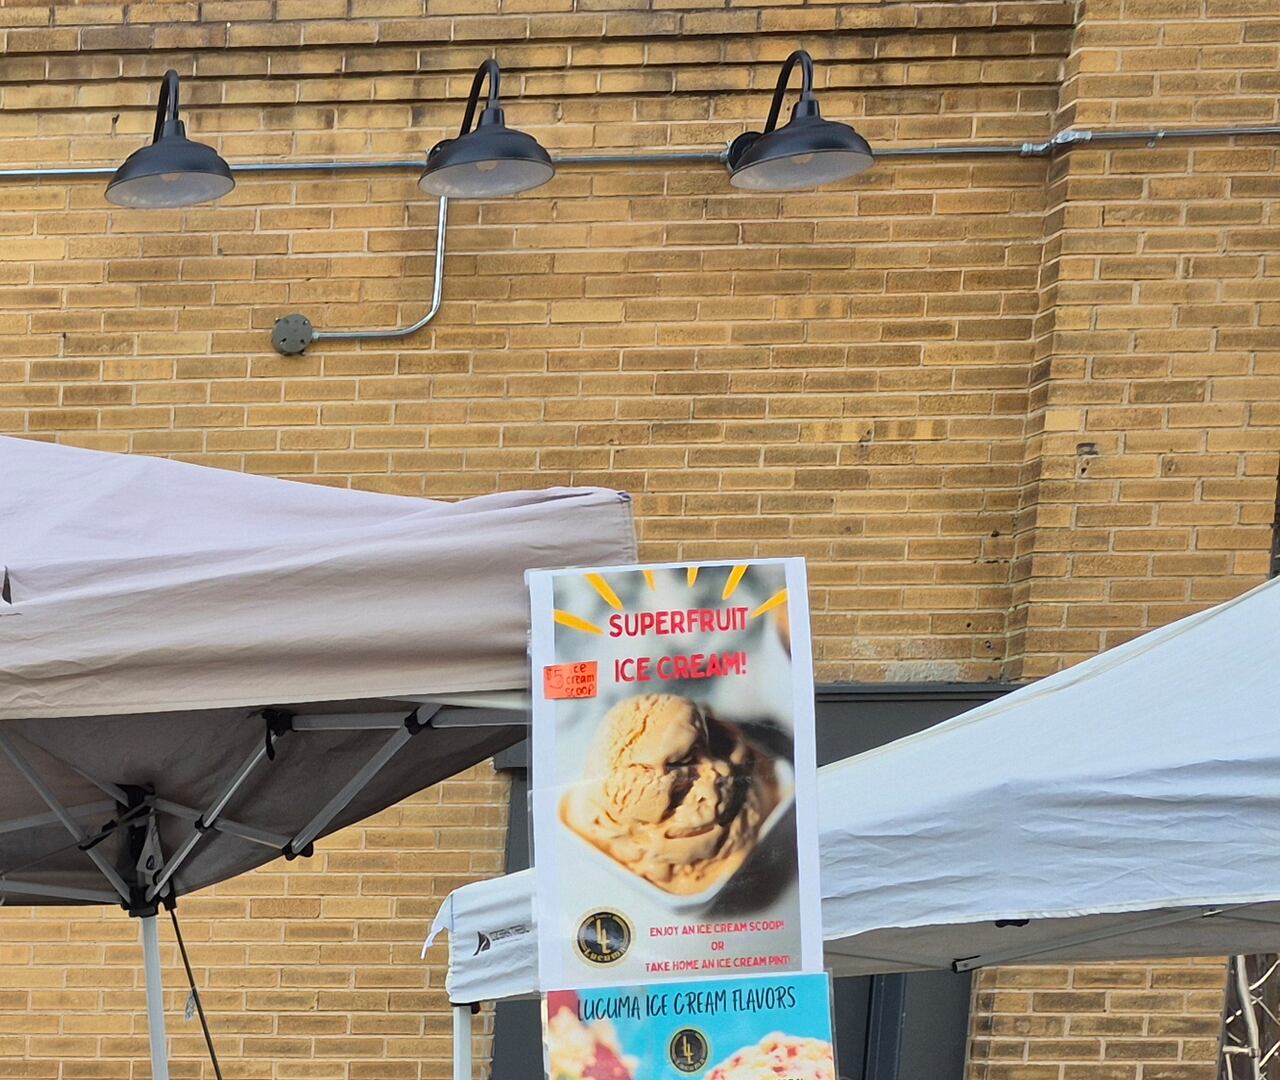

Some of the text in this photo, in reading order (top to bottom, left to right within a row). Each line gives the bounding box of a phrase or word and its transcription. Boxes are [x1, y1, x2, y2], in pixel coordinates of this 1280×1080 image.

[609, 607, 749, 638] SUPERFRUIT
[615, 653, 748, 683] ICE CREAM!
[649, 920, 784, 938] ENJOY AN ICE CREAM SCOOP!
[711, 941, 725, 951] OR
[645, 961, 667, 972] TAKE
[671, 959, 698, 971] HOME
[701, 958, 715, 969] AN
[717, 958, 732, 968] ICE
[734, 956, 766, 968] CREAM
[577, 986, 796, 1021] LUCUMA ICE CREAM FLAVORS
